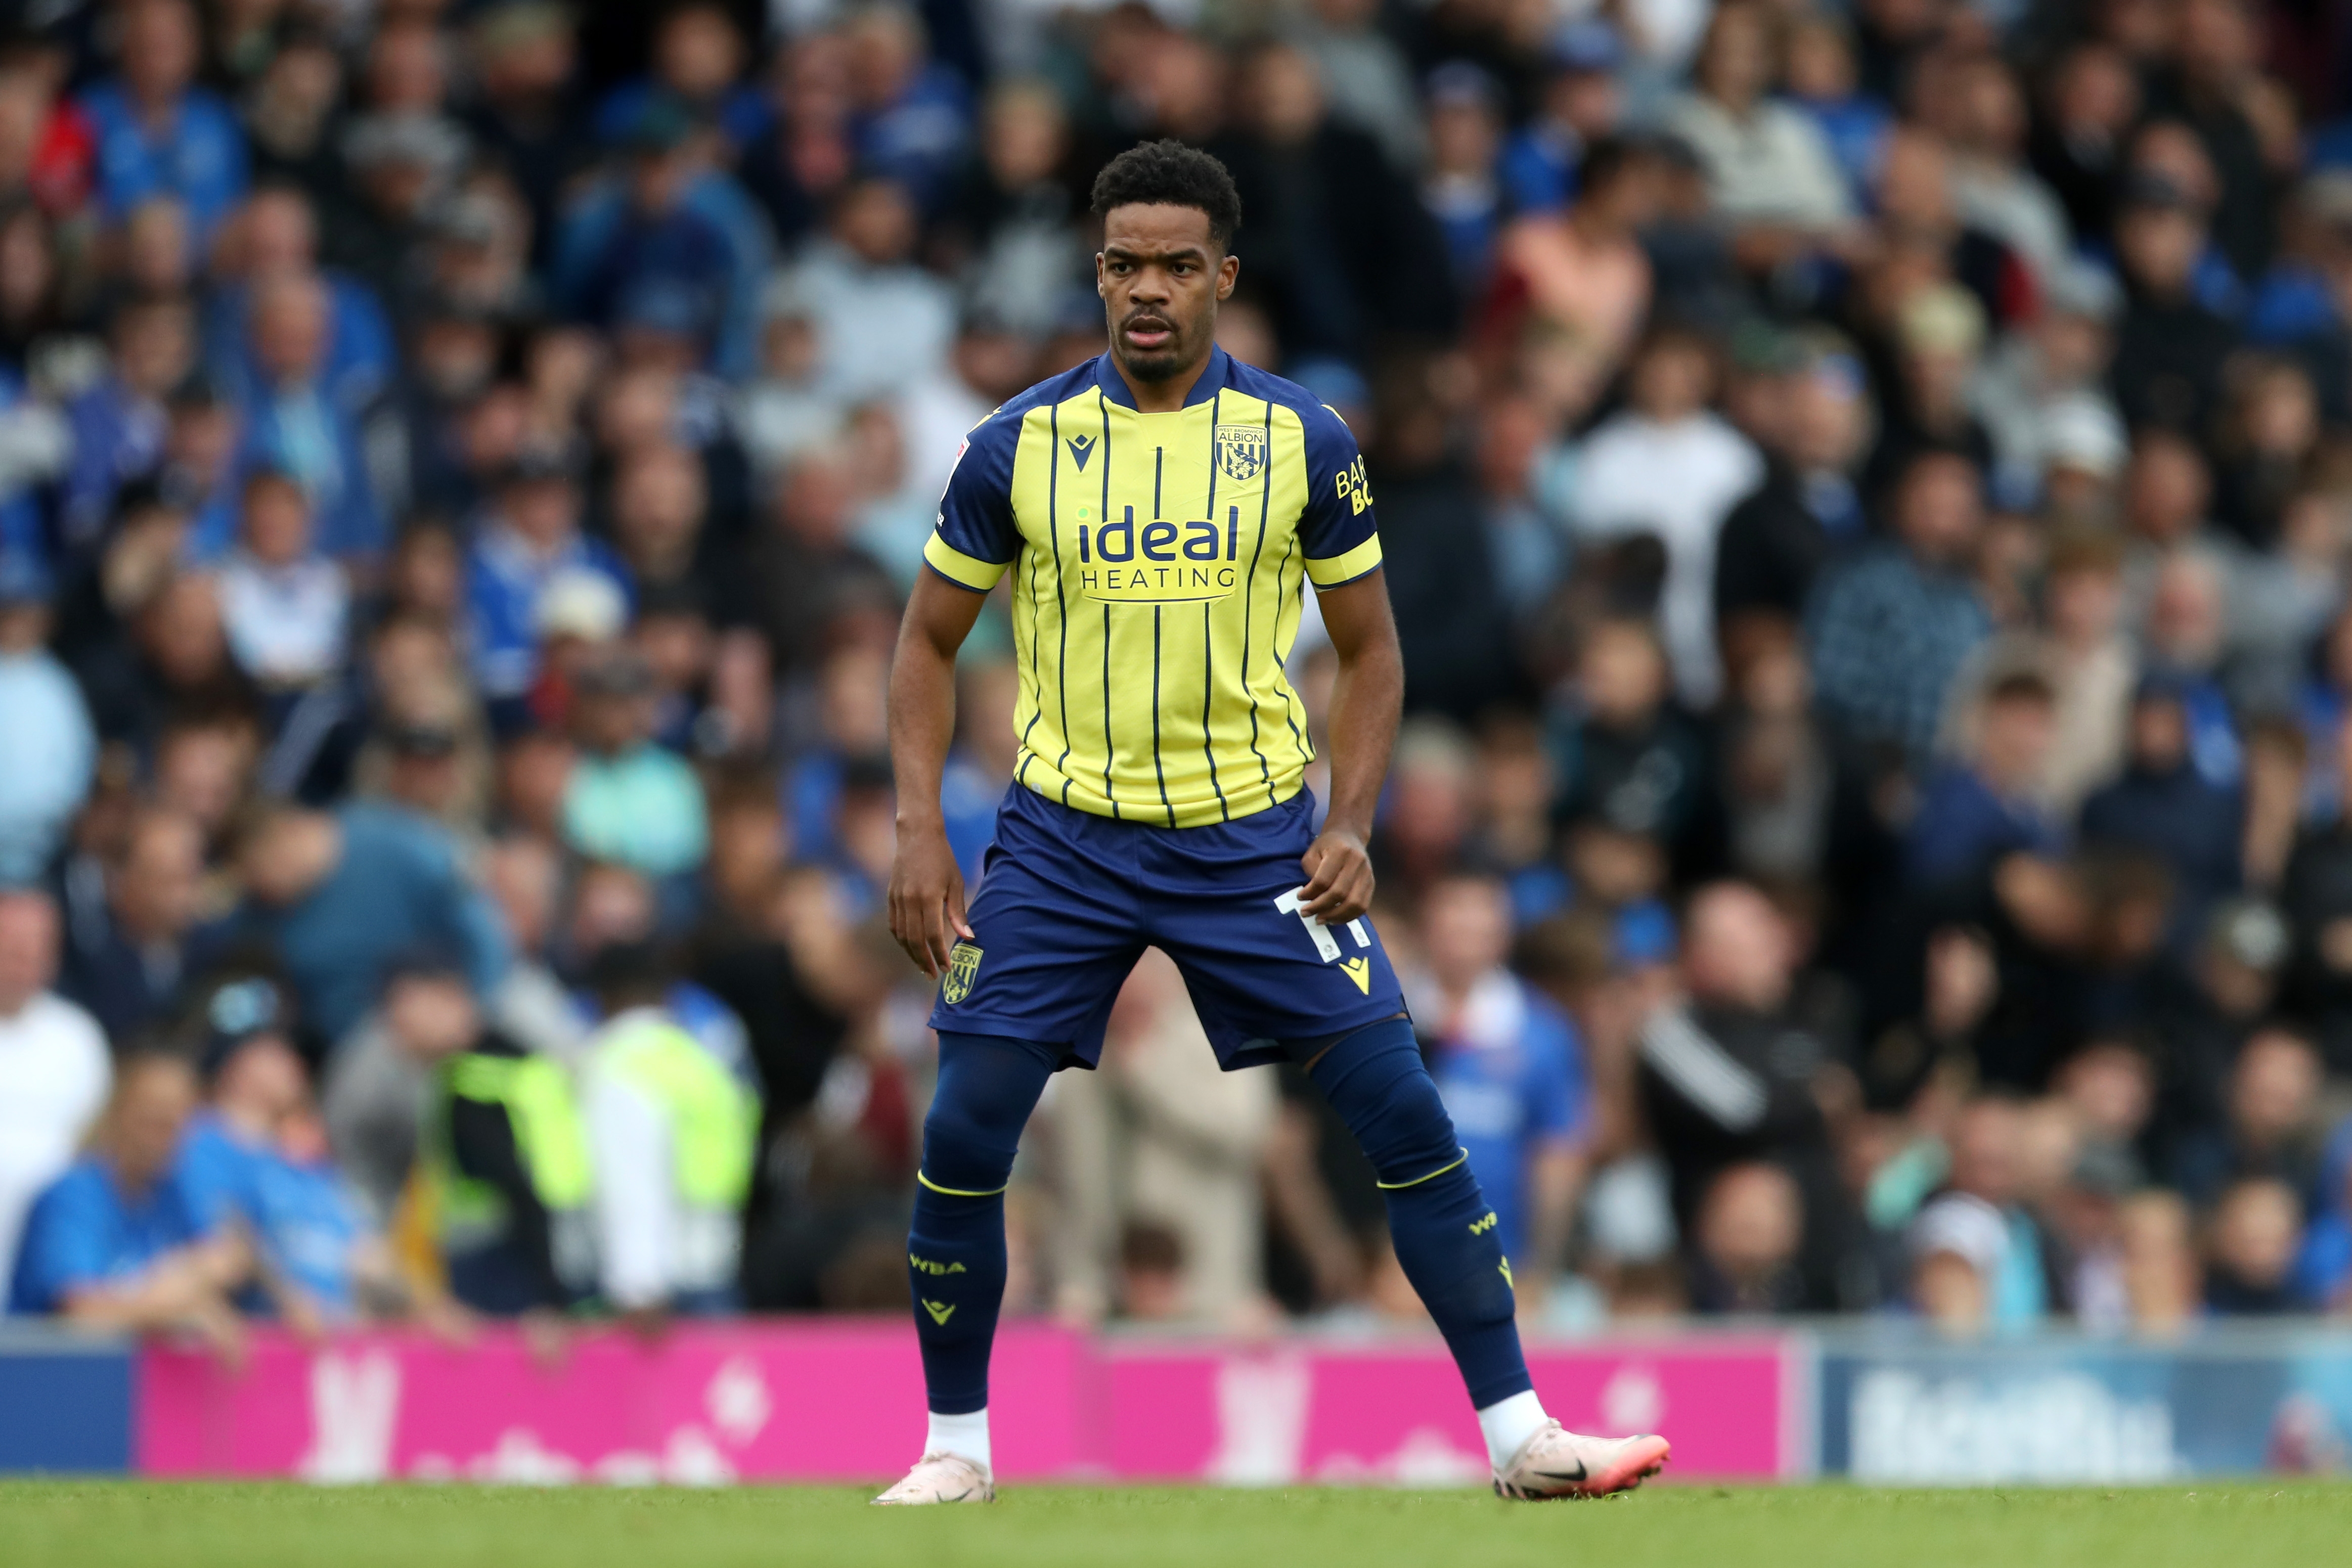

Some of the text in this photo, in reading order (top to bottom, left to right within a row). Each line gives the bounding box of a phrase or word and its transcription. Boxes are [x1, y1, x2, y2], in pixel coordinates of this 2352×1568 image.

[1218, 432, 1262, 443] ALBION
[1078, 505, 1238, 563] ideal
[1081, 567, 1235, 589] HEATING
[909, 1252, 967, 1276] WBA
